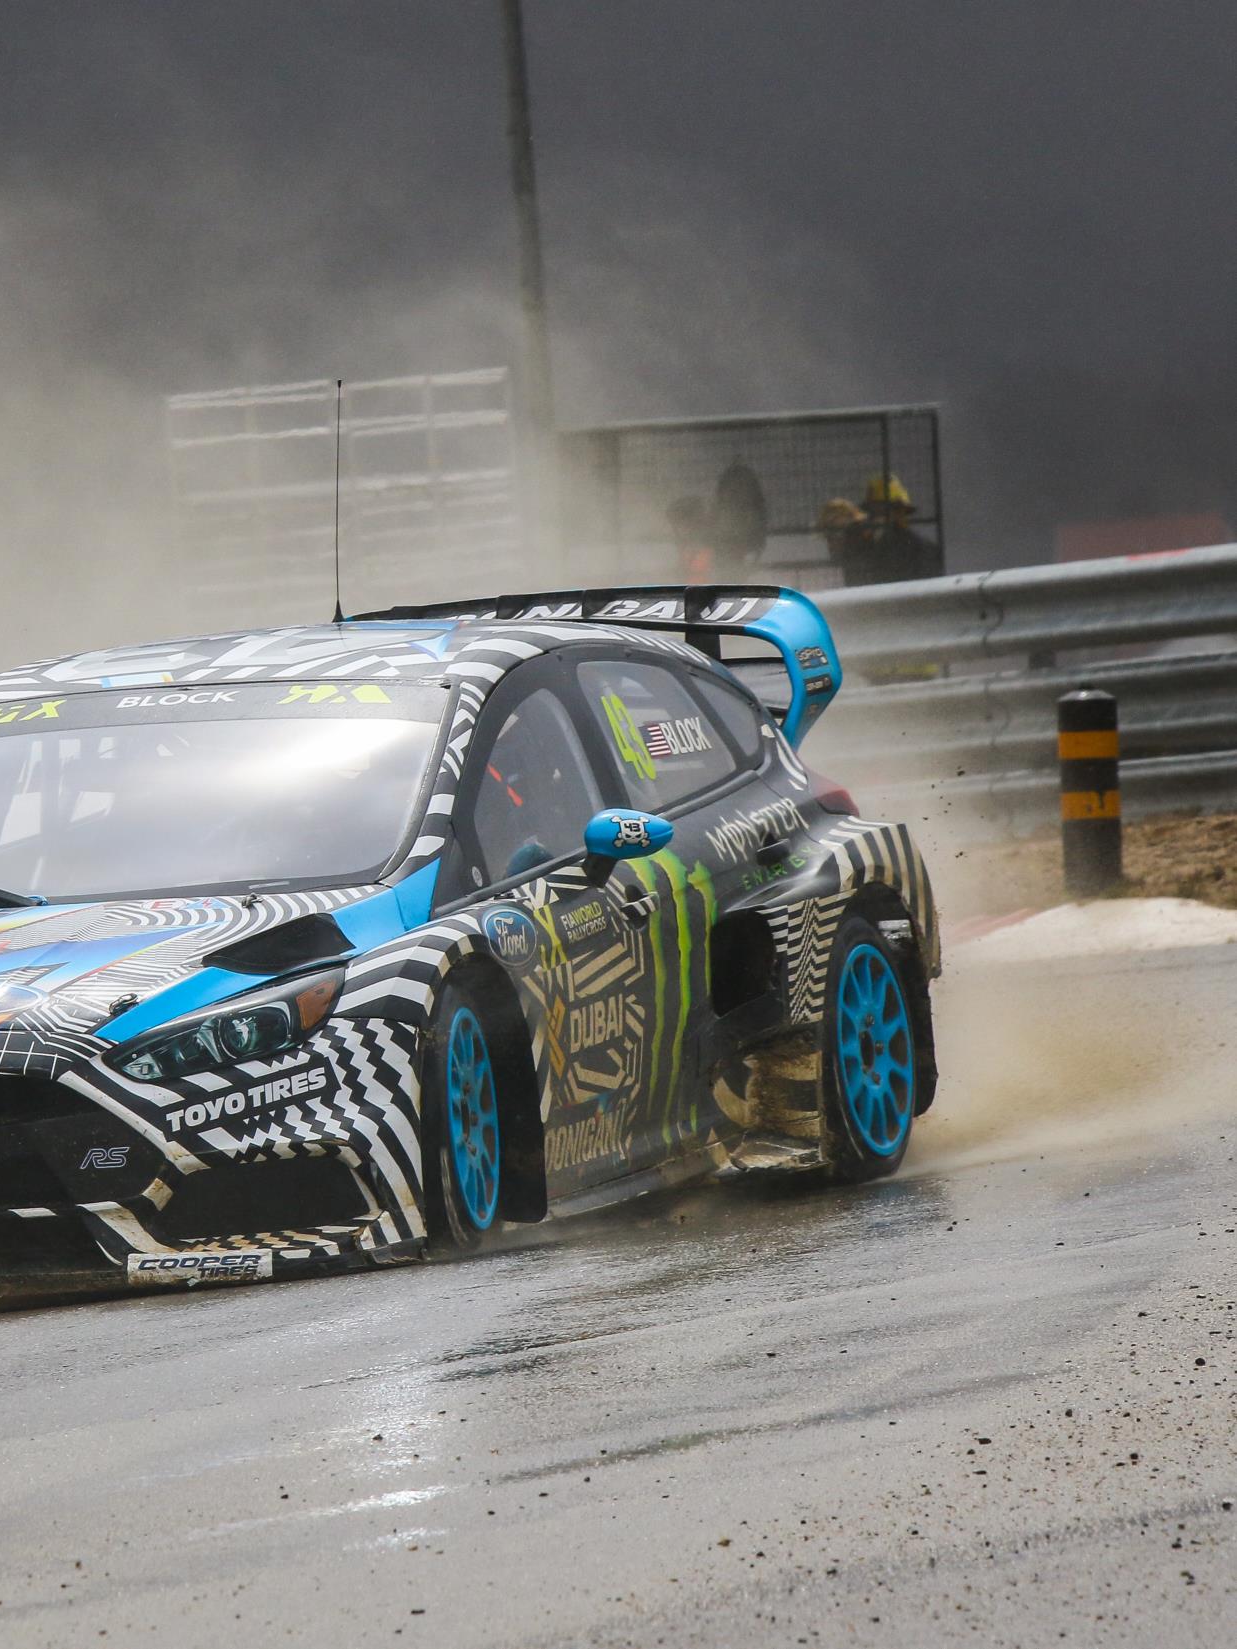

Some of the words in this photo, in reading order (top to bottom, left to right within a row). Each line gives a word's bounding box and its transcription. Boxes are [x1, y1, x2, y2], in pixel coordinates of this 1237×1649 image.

[116, 690, 240, 709] BLOCK
[601, 694, 657, 780] 43
[659, 716, 713, 755] BLOCK
[624, 822, 641, 832] 43
[706, 798, 809, 864] MONSTER
[494, 917, 528, 957] Ford
[566, 916, 607, 944] RALLYCROSS
[570, 993, 624, 1054] DUBAI
[166, 1092, 246, 1133] TOYO
[247, 1067, 327, 1108] TIRES
[80, 1146, 130, 1169] RS
[138, 1254, 262, 1271] COOPER
[196, 1264, 259, 1279] TIRES
